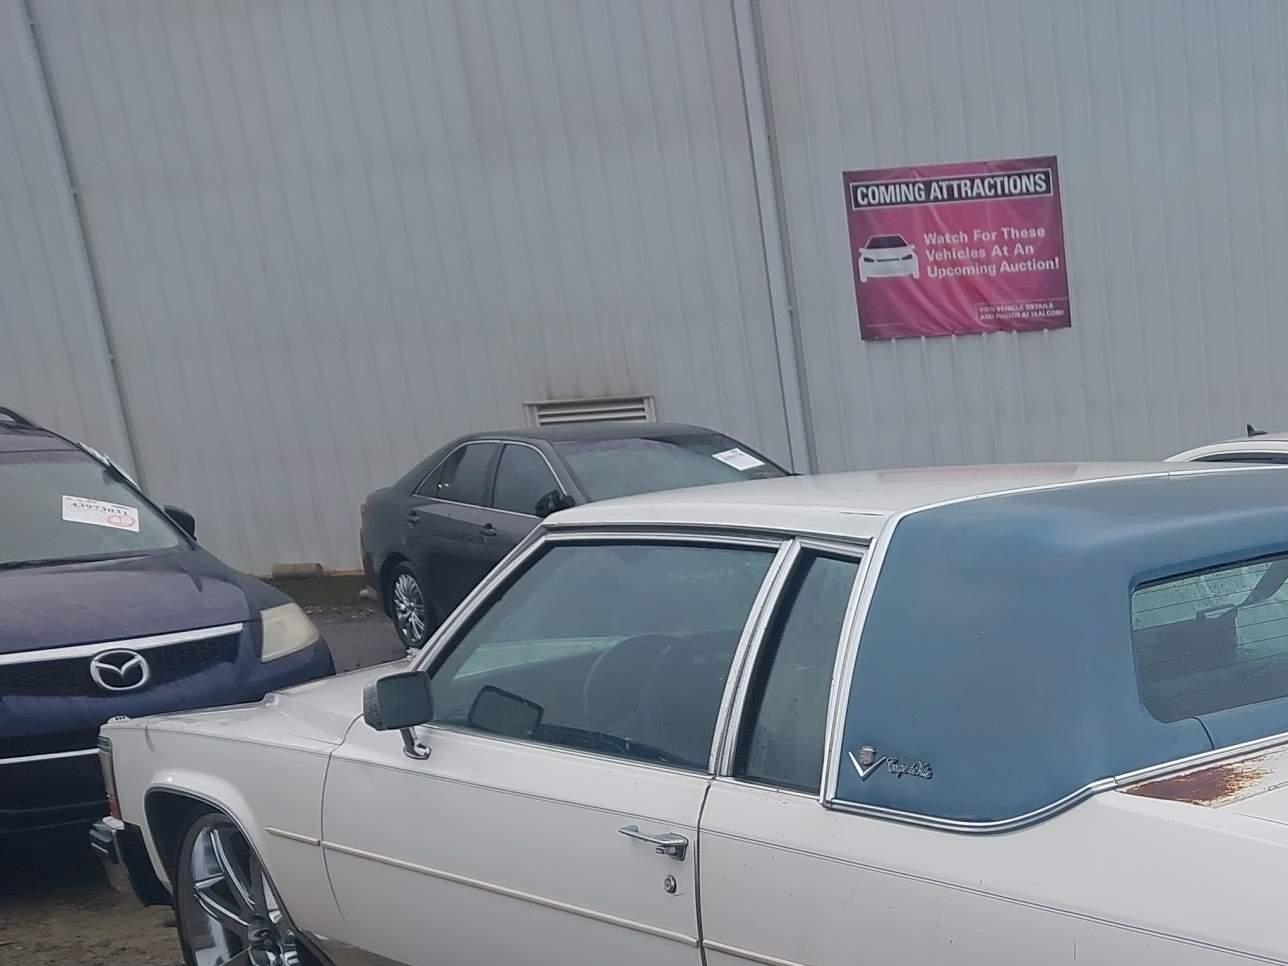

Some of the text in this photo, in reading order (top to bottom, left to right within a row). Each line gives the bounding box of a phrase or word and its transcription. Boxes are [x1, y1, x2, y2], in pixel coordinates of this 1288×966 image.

[857, 173, 1047, 205] COMING ATTRACTIONS
[924, 227, 1045, 245] Watch For These
[925, 243, 1034, 261] Vehicles At An
[927, 256, 1059, 279] Upcoming Auction!
